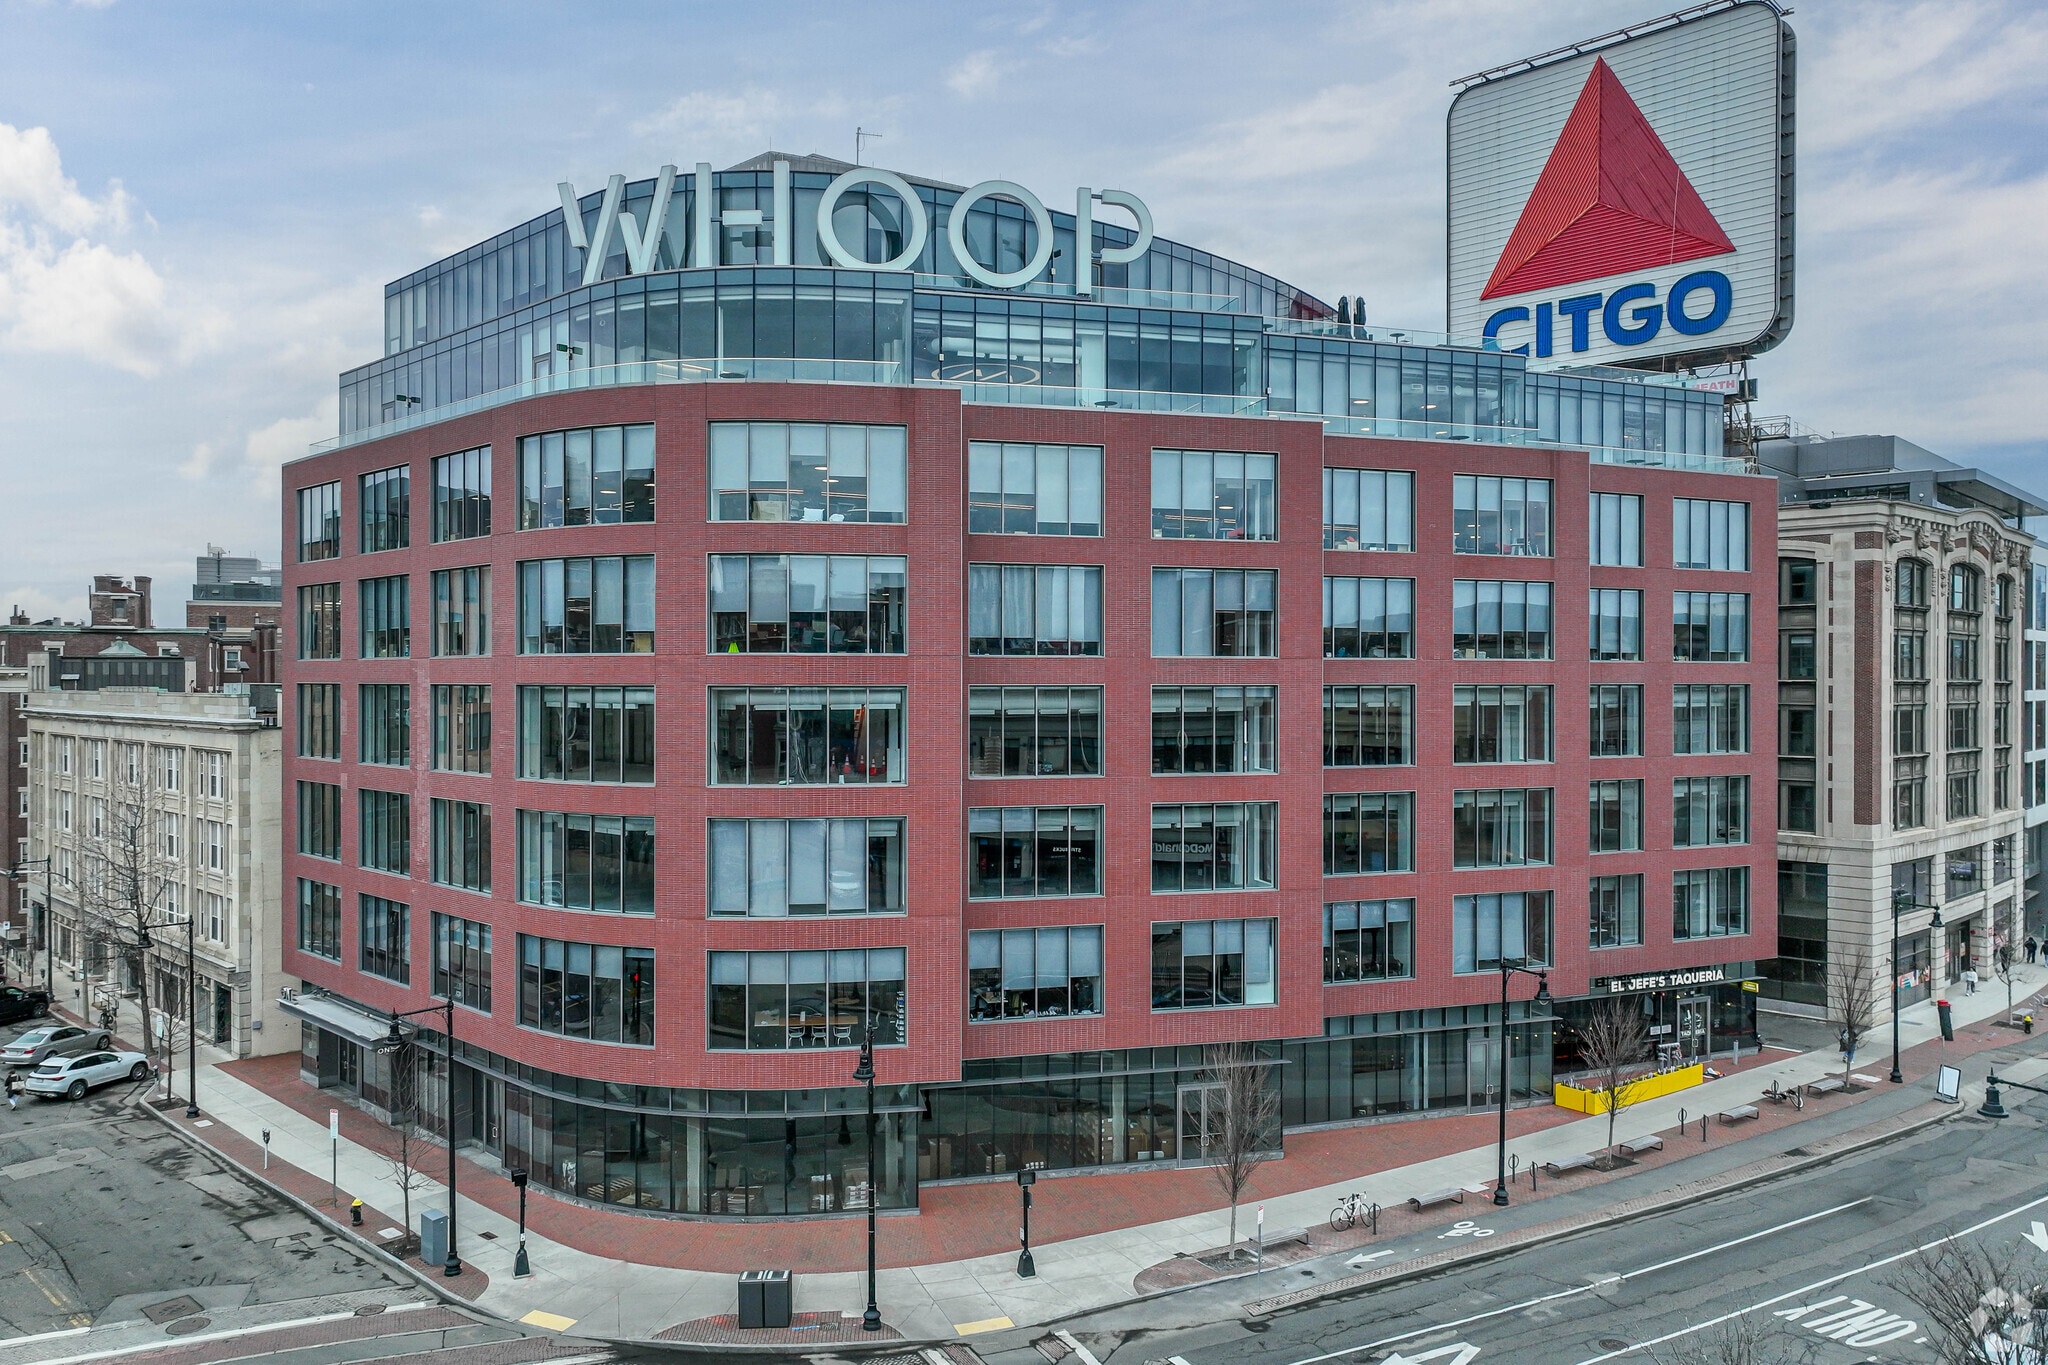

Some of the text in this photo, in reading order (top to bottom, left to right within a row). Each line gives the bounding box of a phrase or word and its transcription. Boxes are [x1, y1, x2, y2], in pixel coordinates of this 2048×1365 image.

[557, 160, 1154, 297] WHOOP
[1482, 270, 1733, 358] CITGO
[1610, 969, 1724, 993] EL JEFE'S TAQUERIA
[1772, 1295, 1918, 1348] ONLY
